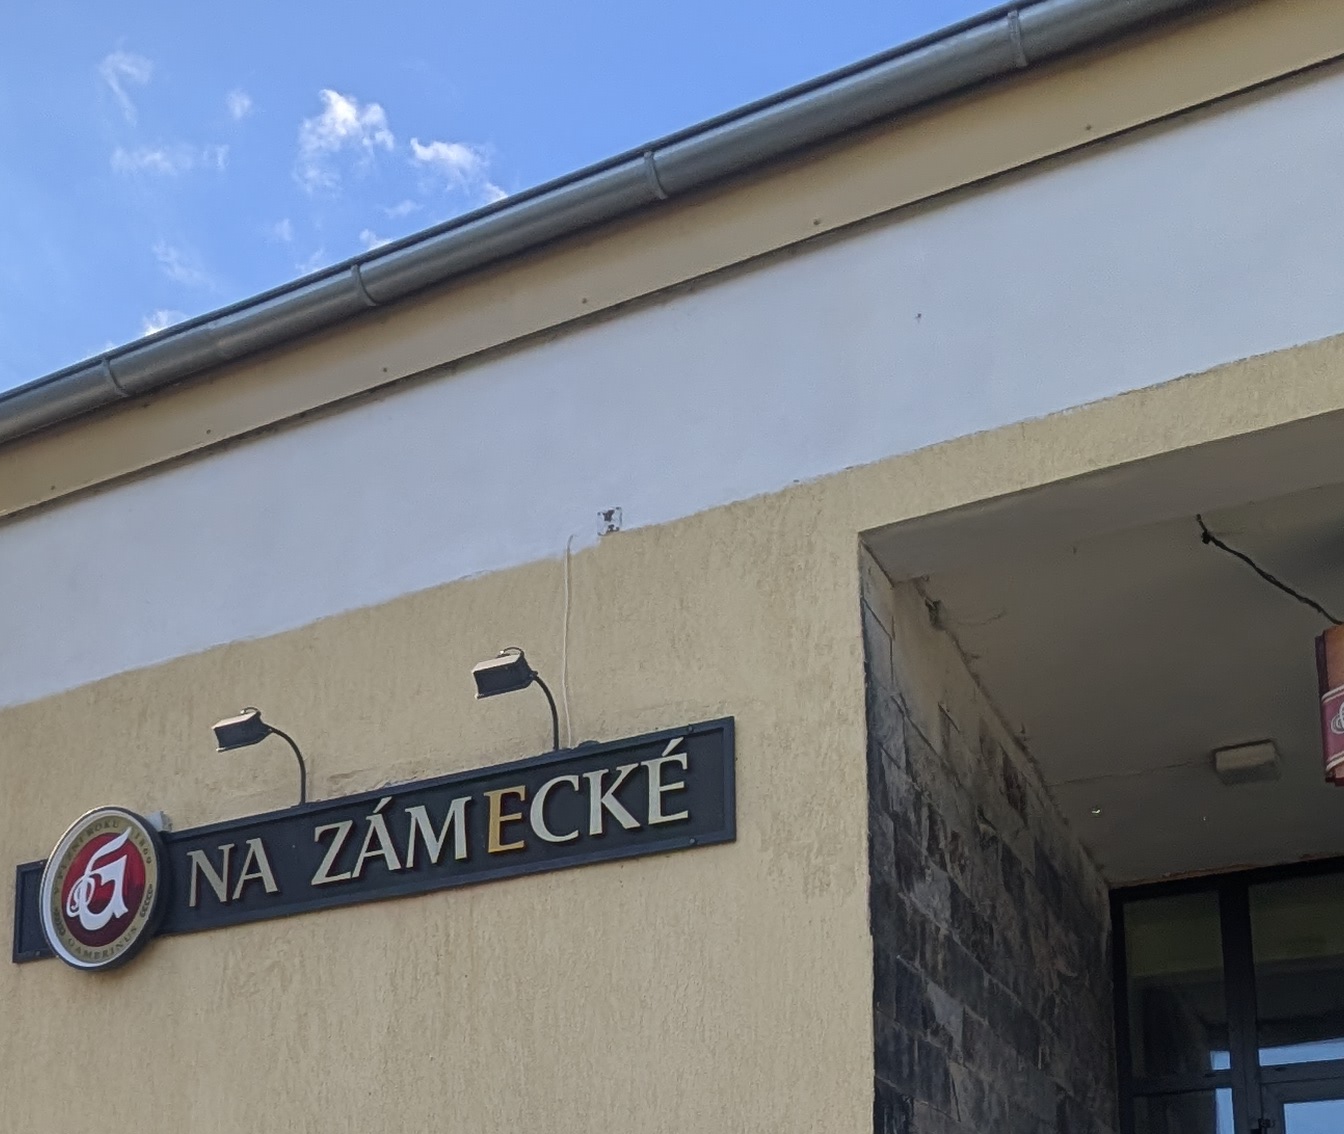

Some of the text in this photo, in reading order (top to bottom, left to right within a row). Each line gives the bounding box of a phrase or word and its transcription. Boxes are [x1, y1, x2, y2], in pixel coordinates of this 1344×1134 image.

[186, 738, 692, 908] NA ZÁMECKÉ
[67, 926, 138, 959] GAMBRINUS
